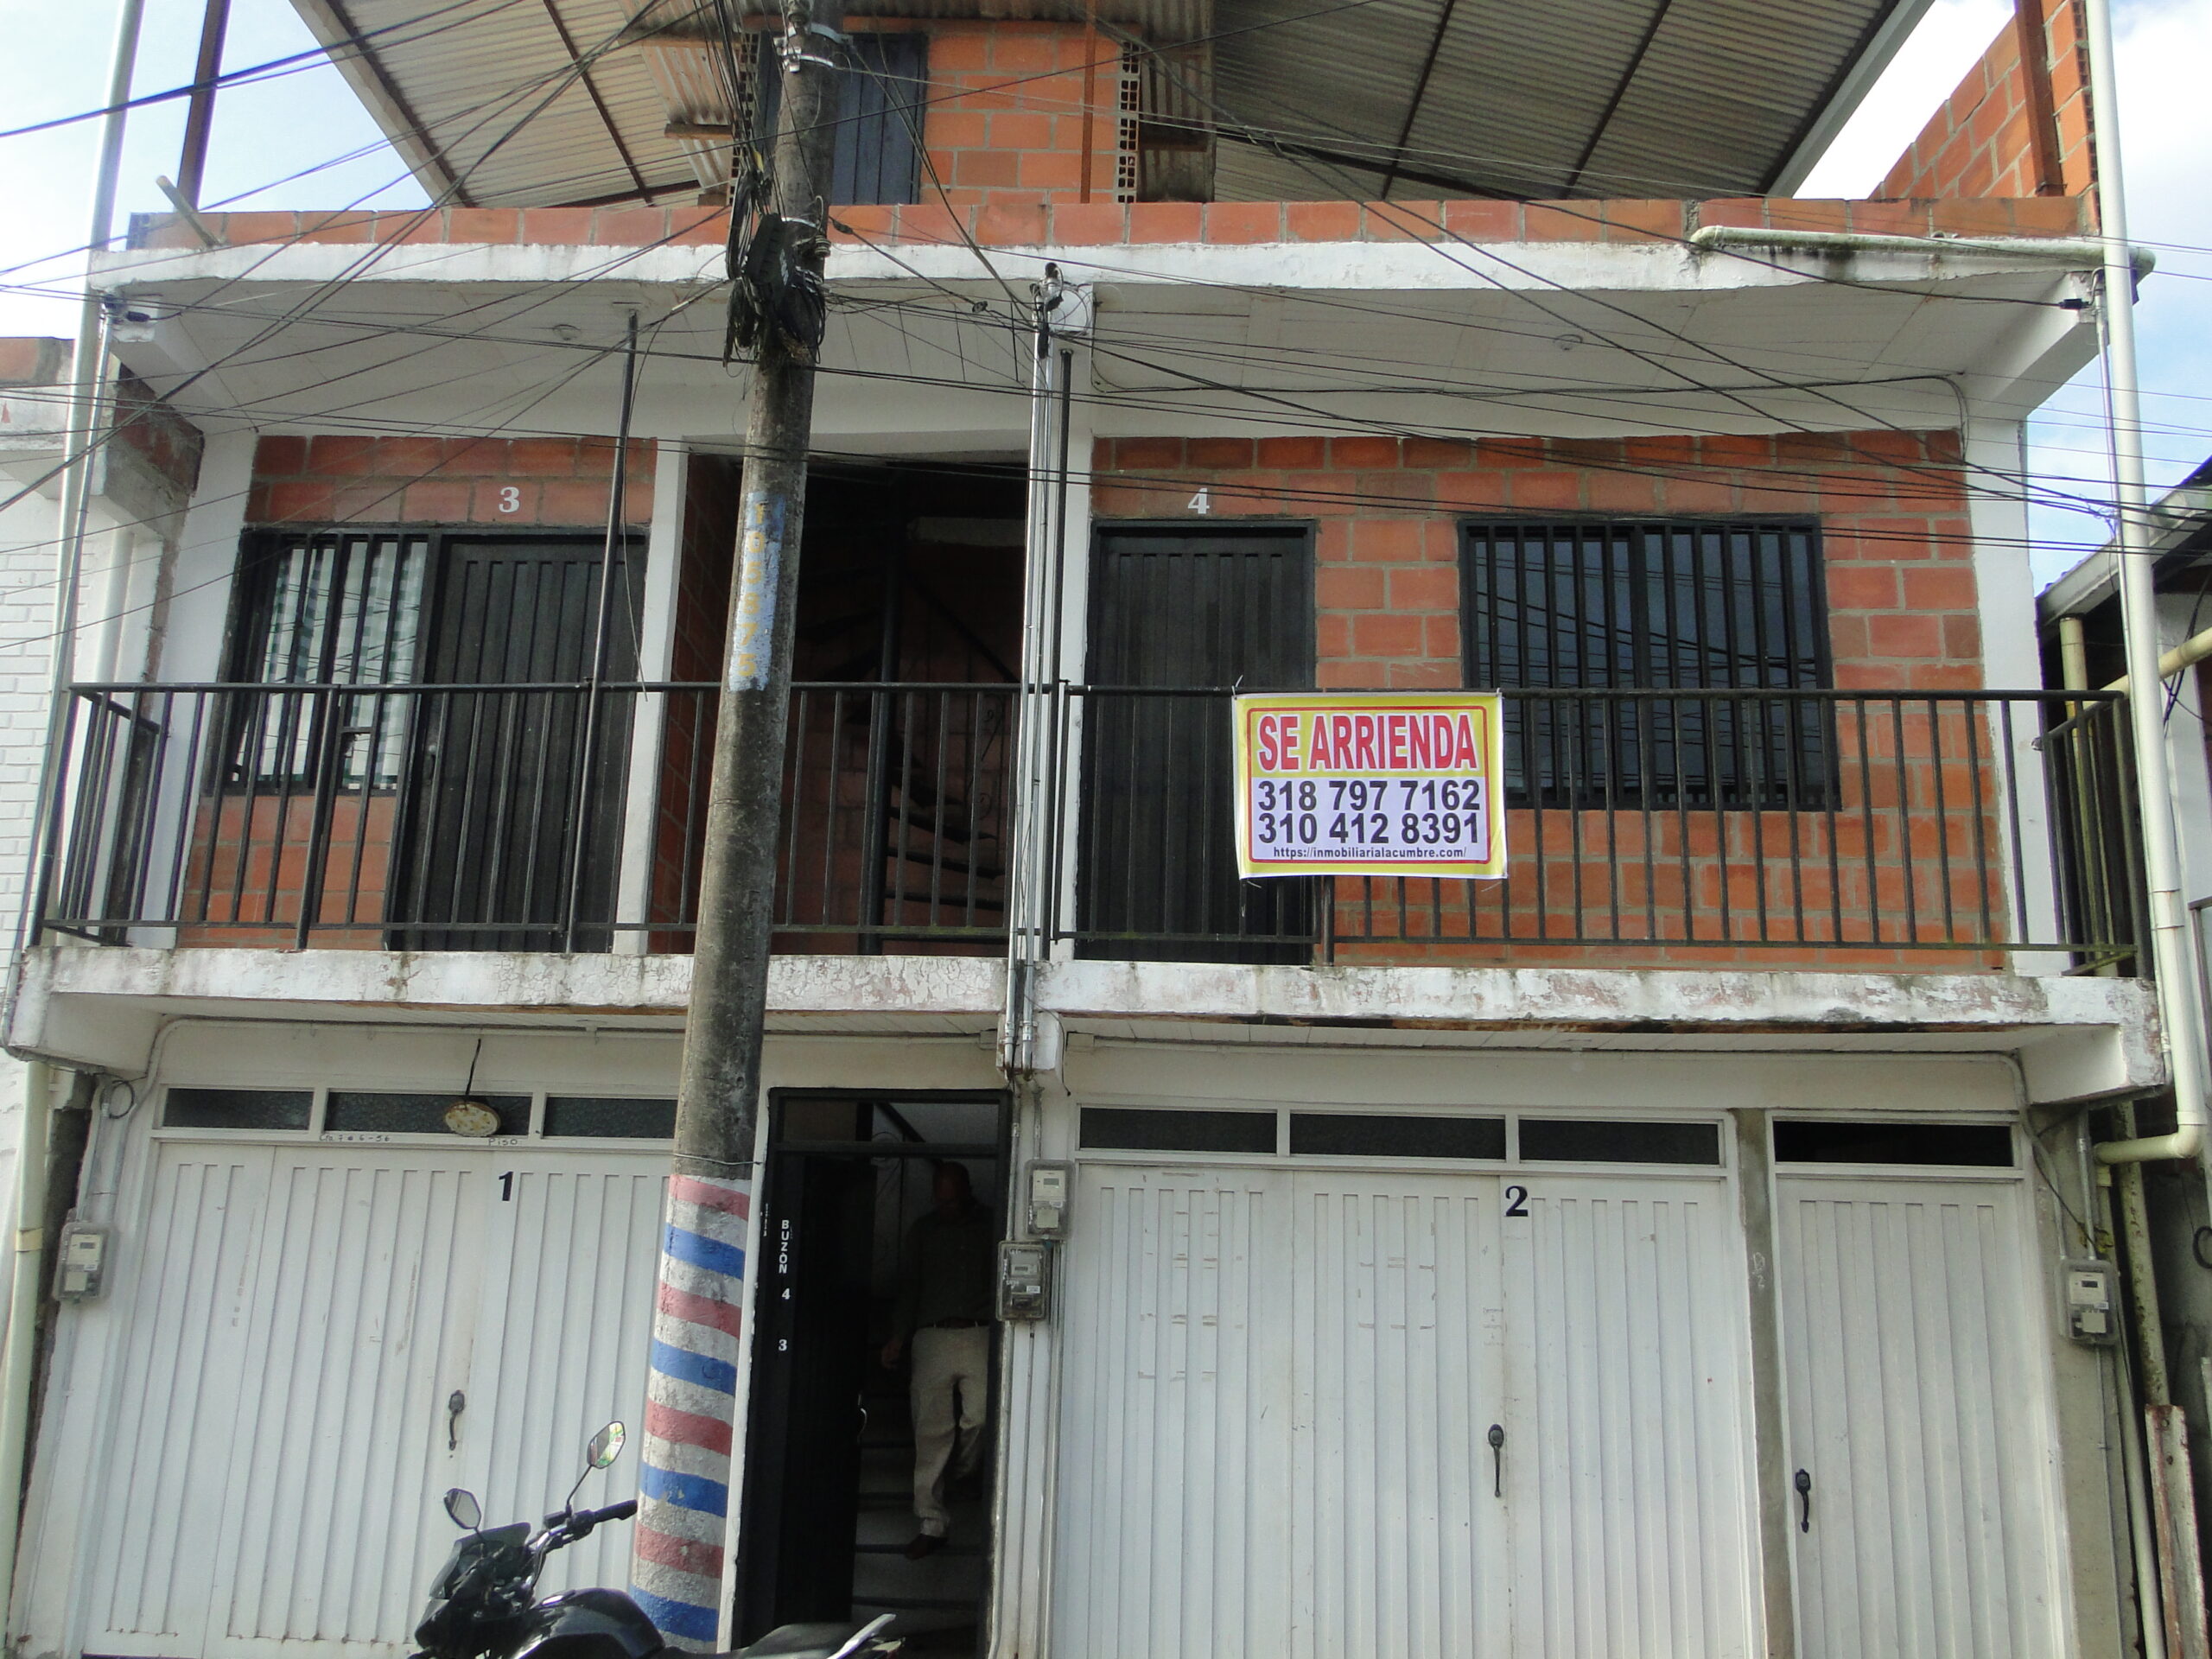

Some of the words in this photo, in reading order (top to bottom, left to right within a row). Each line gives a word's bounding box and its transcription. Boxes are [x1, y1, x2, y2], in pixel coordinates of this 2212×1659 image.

[499, 486, 520, 513] 3
[1187, 487, 1210, 514] 4
[1259, 715, 1299, 771] SE
[1309, 715, 1478, 770] ARRIENDA
[1258, 780, 1317, 810] 318
[1329, 780, 1388, 810] 797
[1400, 779, 1481, 810] 7162
[1258, 812, 1318, 843] 310
[1329, 812, 1389, 843] 412
[1402, 812, 1478, 843] 8391
[1274, 847, 1467, 860] https://inmobiliarialacumbre.com/
[499, 1171, 514, 1202] 1
[1505, 1185, 1529, 1217] 2
[782, 1287, 791, 1300] 4
[779, 1339, 787, 1351] 3
